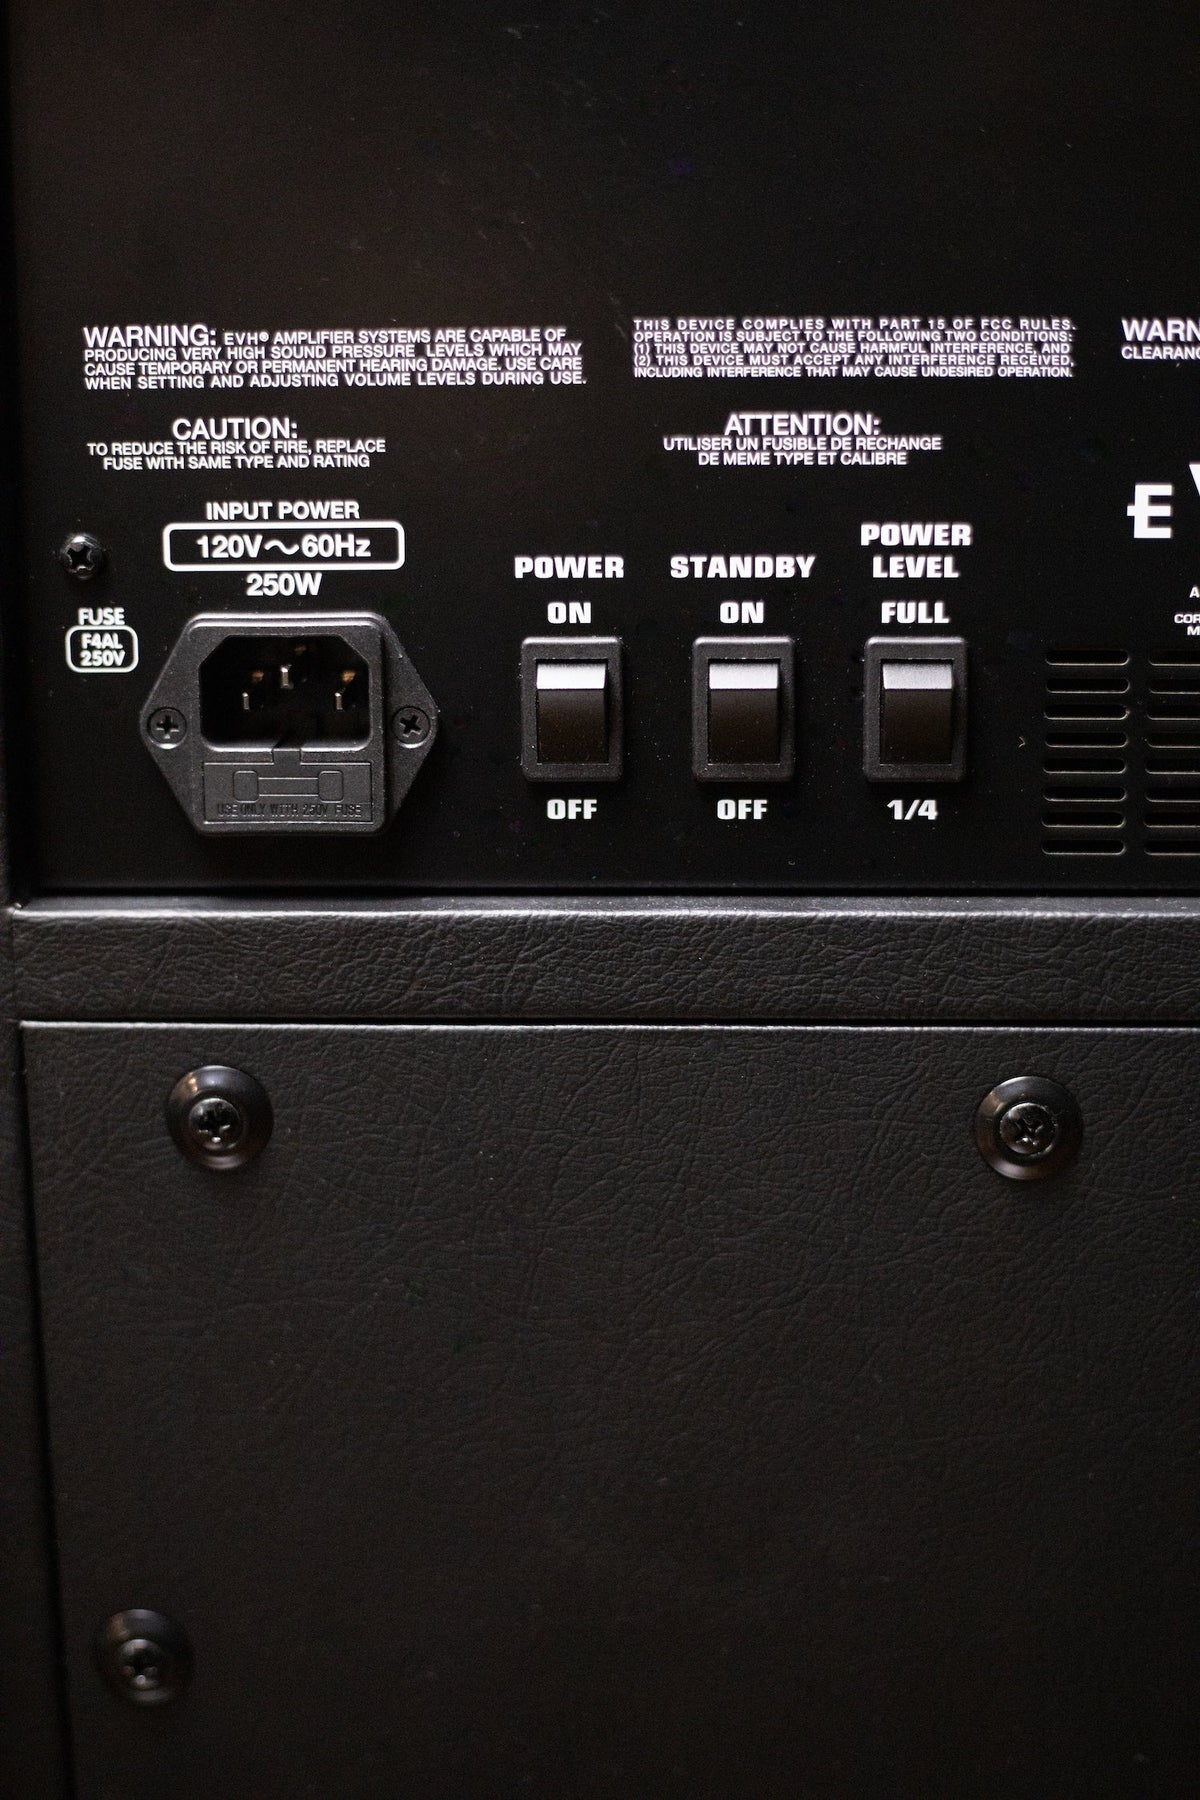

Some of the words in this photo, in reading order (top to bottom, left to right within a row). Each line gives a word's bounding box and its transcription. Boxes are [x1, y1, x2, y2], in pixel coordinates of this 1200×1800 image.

[634, 320, 670, 330] THIS
[678, 320, 735, 330] DEVICE
[742, 319, 824, 330] COMPLIES
[832, 319, 871, 330] WITH
[880, 319, 920, 330] PART
[928, 319, 945, 330] 15
[953, 319, 973, 330] OF
[981, 319, 1012, 330] FCC
[1019, 319, 1076, 330] RULES.
[1121, 317, 1200, 341] WARN
[83, 324, 216, 348] WARNING:
[274, 331, 354, 344] AMPLIFIER
[358, 330, 430, 344] SYSTEMS
[435, 329, 466, 343] ARE
[470, 329, 540, 343] CAPABLE
[545, 329, 566, 342] OF
[634, 332, 714, 342] OPERATION
[719, 332, 733, 342] IS
[736, 331, 800, 342] SUBJECT
[804, 331, 823, 342] TO
[827, 331, 853, 342] THE
[858, 331, 941, 342] FOLLOWING
[945, 331, 976, 342] TWO
[980, 331, 1073, 342] CONDITIONS:
[84, 348, 176, 362] PRODUCING
[182, 347, 221, 361] VERY
[227, 347, 265, 360] HIGH
[271, 345, 326, 359] SOUND
[333, 344, 415, 358] PRESSURE
[426, 344, 484, 357] LEVELS
[490, 343, 541, 356] WHICH
[549, 343, 582, 356] MAY
[634, 343, 650, 354] (1)
[655, 344, 685, 354] THIS
[690, 344, 739, 354] DEVICE
[743, 343, 774, 354] MAY
[778, 343, 806, 354] NOT
[810, 343, 855, 353] CAUSE
[861, 343, 926, 354] HARMFUL
[931, 343, 1037, 355] INTERFERENCE,
[1041, 343, 1070, 354] AND
[84, 362, 135, 376] CAUSE
[139, 361, 232, 375] TEMPORARY
[236, 361, 258, 374] OR
[262, 360, 356, 372] PERMANENT
[360, 358, 427, 372] HEARING
[432, 358, 501, 371] DAMAGE.
[505, 357, 536, 370] USE
[540, 357, 582, 370] CARE
[634, 355, 650, 367] (2)
[656, 356, 688, 366] THIS
[693, 355, 743, 366] DEVICE
[749, 355, 788, 366] MUST
[794, 355, 850, 366] ACCEPT
[855, 355, 884, 365] ANY
[888, 355, 995, 365] INTERFERENCE
[1001, 355, 1074, 367] RECEIVED,
[85, 377, 132, 390] WHEN
[137, 376, 204, 389] SETTING
[210, 375, 244, 388] AND
[250, 374, 338, 387] ADJUSTING
[344, 373, 411, 386] VOLUME
[418, 373, 476, 386] LEVELS
[482, 372, 543, 385] DURING
[550, 372, 586, 385] USE.
[634, 367, 702, 378] INCLUDING
[707, 367, 801, 378] INTERFERENCE
[806, 367, 838, 377] THAT
[842, 367, 870, 377] MAY
[874, 367, 917, 377] CAUSE
[921, 367, 993, 377] UNDESIRED
[998, 367, 1073, 377] OPERATION.
[172, 418, 298, 440] CAUTION:
[724, 414, 880, 436] ATTENTION:
[88, 442, 108, 456] TO
[112, 442, 174, 456] REDUCE
[176, 442, 208, 455] THE
[211, 442, 246, 454] RISK
[250, 441, 271, 454] OF
[274, 440, 312, 456] FIRE,
[316, 440, 386, 453] REPLACE
[663, 438, 732, 451] UTILISER
[736, 438, 759, 451] UN
[763, 438, 826, 450] FUSIBLE
[831, 438, 852, 450] DE
[856, 438, 941, 450] RECHANGE
[104, 457, 143, 470] FUSE
[146, 456, 185, 469] WITH
[188, 456, 231, 469] SAME
[236, 456, 273, 468] TYPE
[277, 455, 310, 468] AND
[314, 454, 370, 468] RATING
[698, 453, 719, 466] DE
[723, 453, 770, 465] MEME
[774, 452, 813, 465] TYPE
[818, 452, 837, 465] ET
[840, 452, 907, 465] CALIBRE
[206, 502, 273, 520] INPUT
[279, 501, 360, 519] POWER
[860, 523, 973, 546] POWER
[514, 556, 624, 579] POWER
[670, 555, 816, 579] STANDBY
[872, 556, 959, 578] LEVEL
[246, 573, 322, 596] 250W
[78, 607, 125, 625] FUSE
[547, 602, 592, 624] ON
[720, 602, 764, 624] ON
[881, 602, 949, 624] FULL
[81, 632, 123, 649] F4AL
[80, 649, 126, 666] 250V
[217, 804, 238, 817] USE
[335, 804, 361, 817] FUSE
[546, 800, 598, 820] OFF
[717, 800, 768, 820] OFF
[887, 800, 937, 820] 1/4
